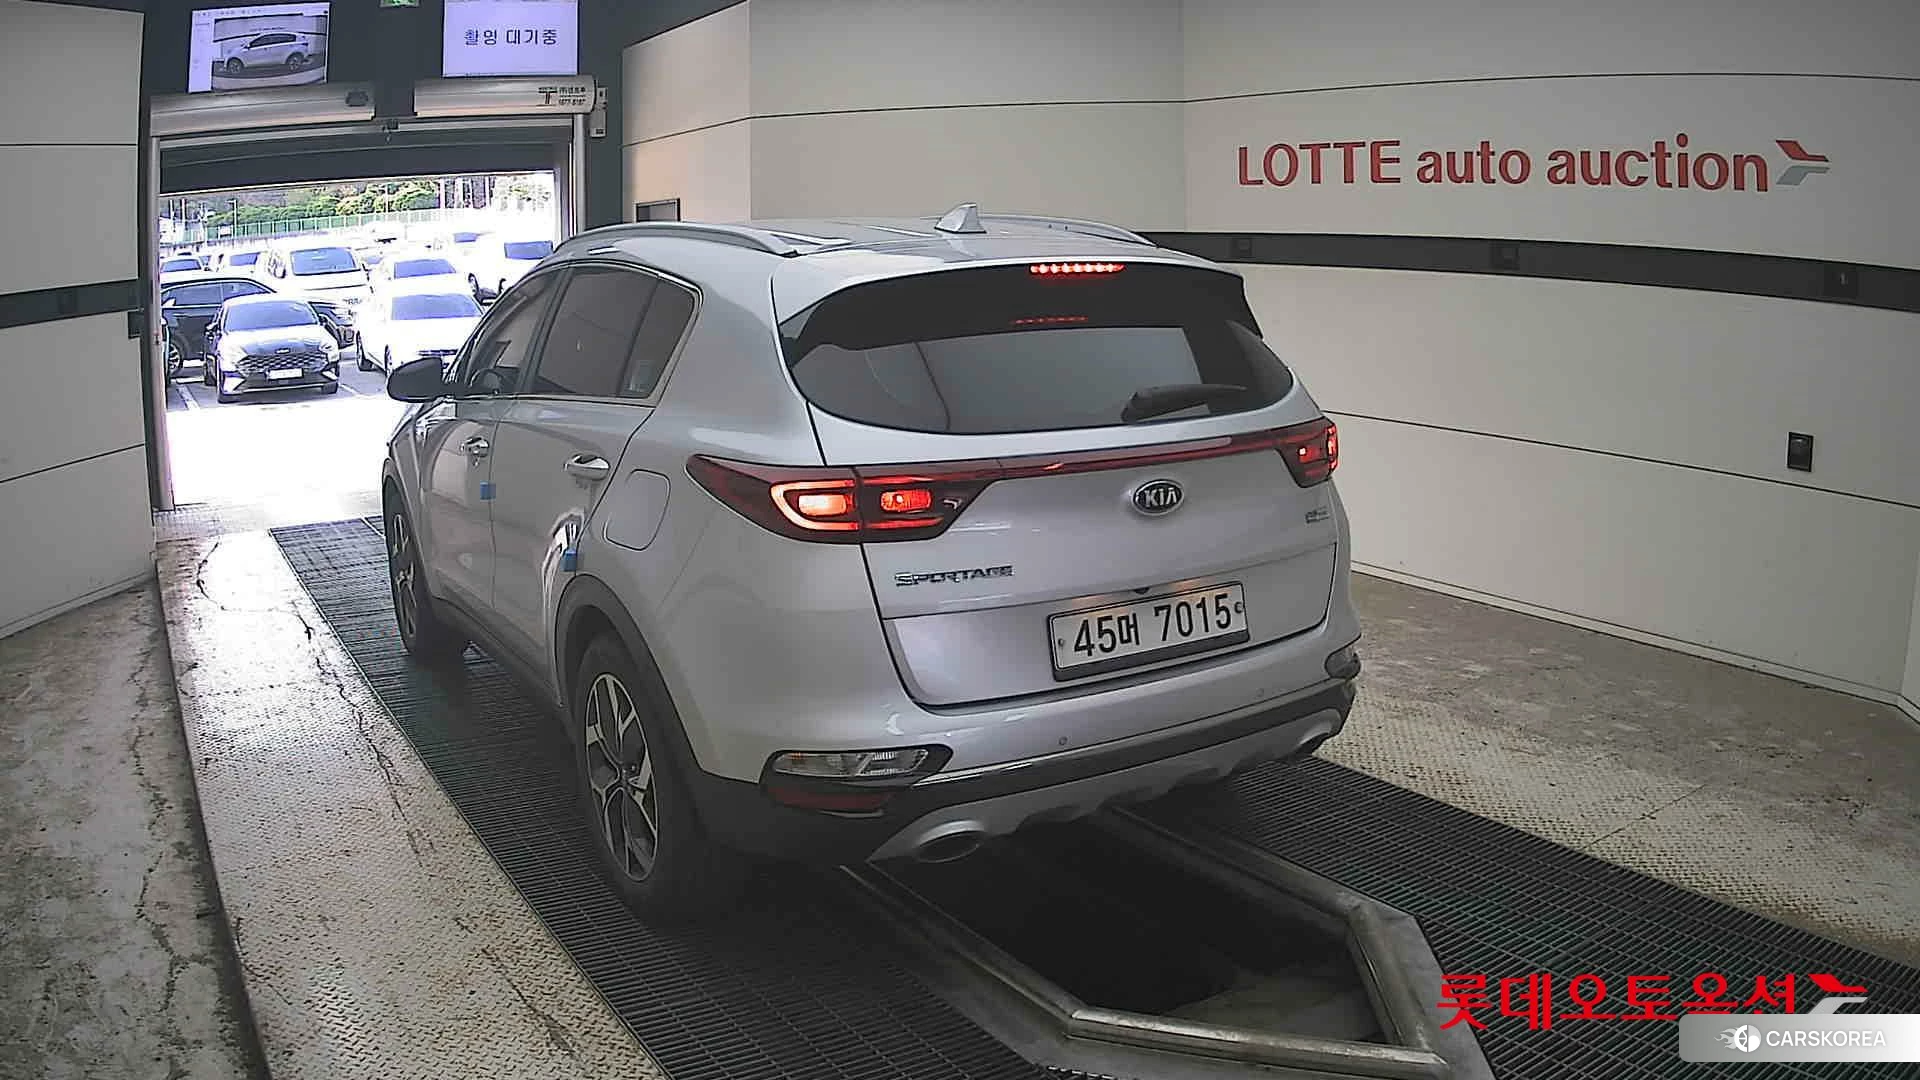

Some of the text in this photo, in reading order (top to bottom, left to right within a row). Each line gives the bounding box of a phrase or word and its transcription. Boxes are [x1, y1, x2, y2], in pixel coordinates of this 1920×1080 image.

[465, 29, 558, 46] 촬영 대기중
[1238, 133, 1768, 192] LOTTE auto auction
[1144, 487, 1177, 508] KIA
[895, 565, 1013, 587] SPORTAGE
[1073, 593, 1232, 657] 45머 7015
